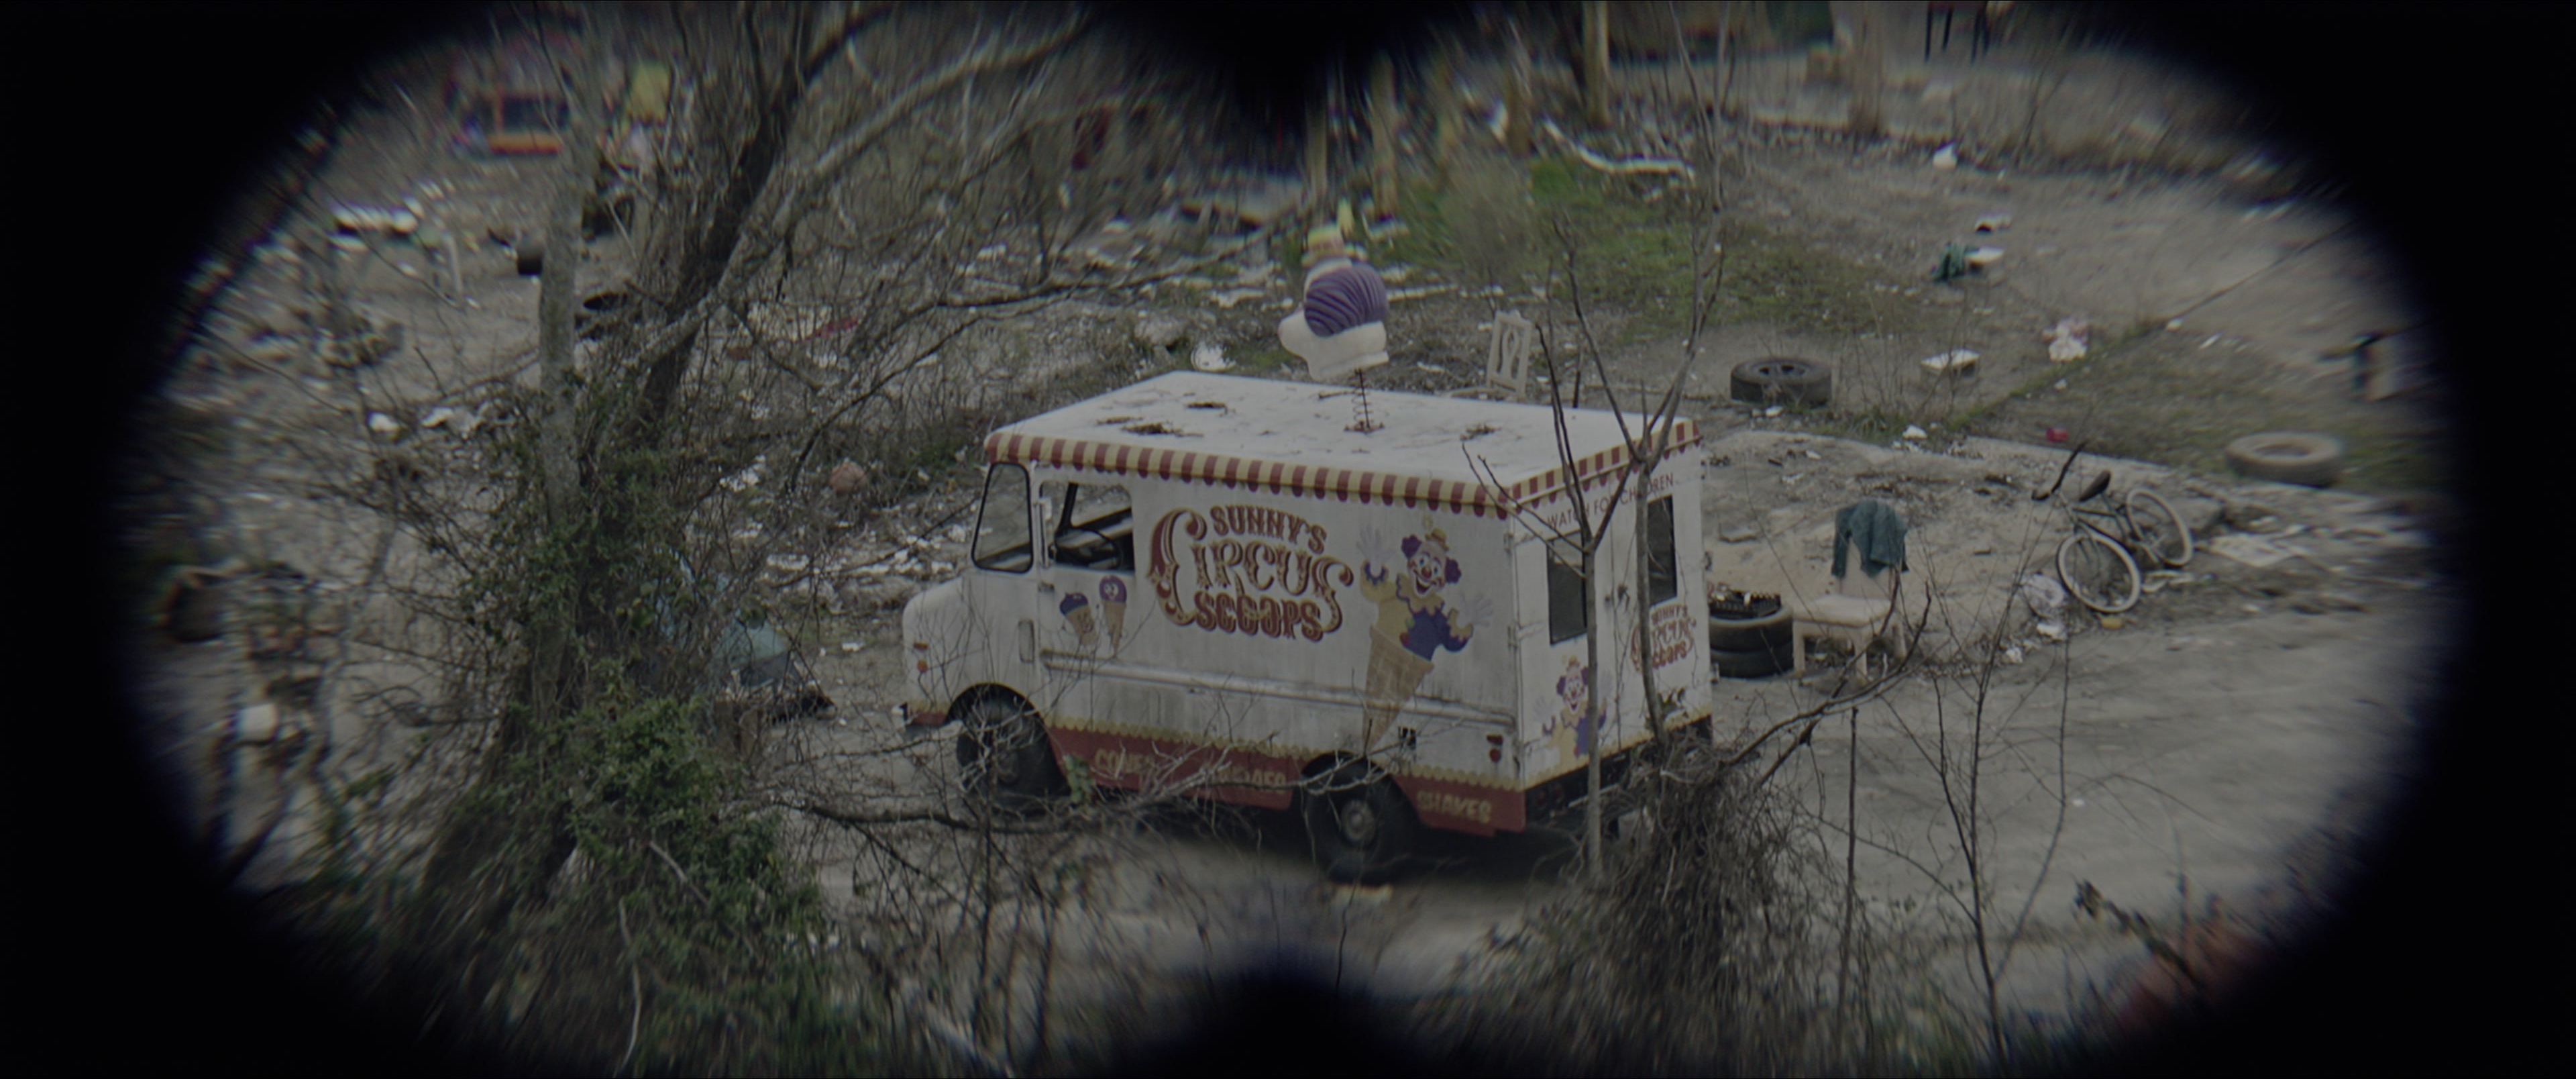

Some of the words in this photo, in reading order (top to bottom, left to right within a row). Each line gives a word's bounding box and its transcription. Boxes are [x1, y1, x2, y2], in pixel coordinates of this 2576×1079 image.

[1210, 505, 1328, 555] SUNNY'S
[1594, 495, 1613, 515] FO
[1146, 508, 1354, 633] CIRCUS
[1194, 590, 1324, 642] SCOOPS
[1630, 616, 1697, 673] CRCUS
[1416, 789, 1492, 825] SHAKES
